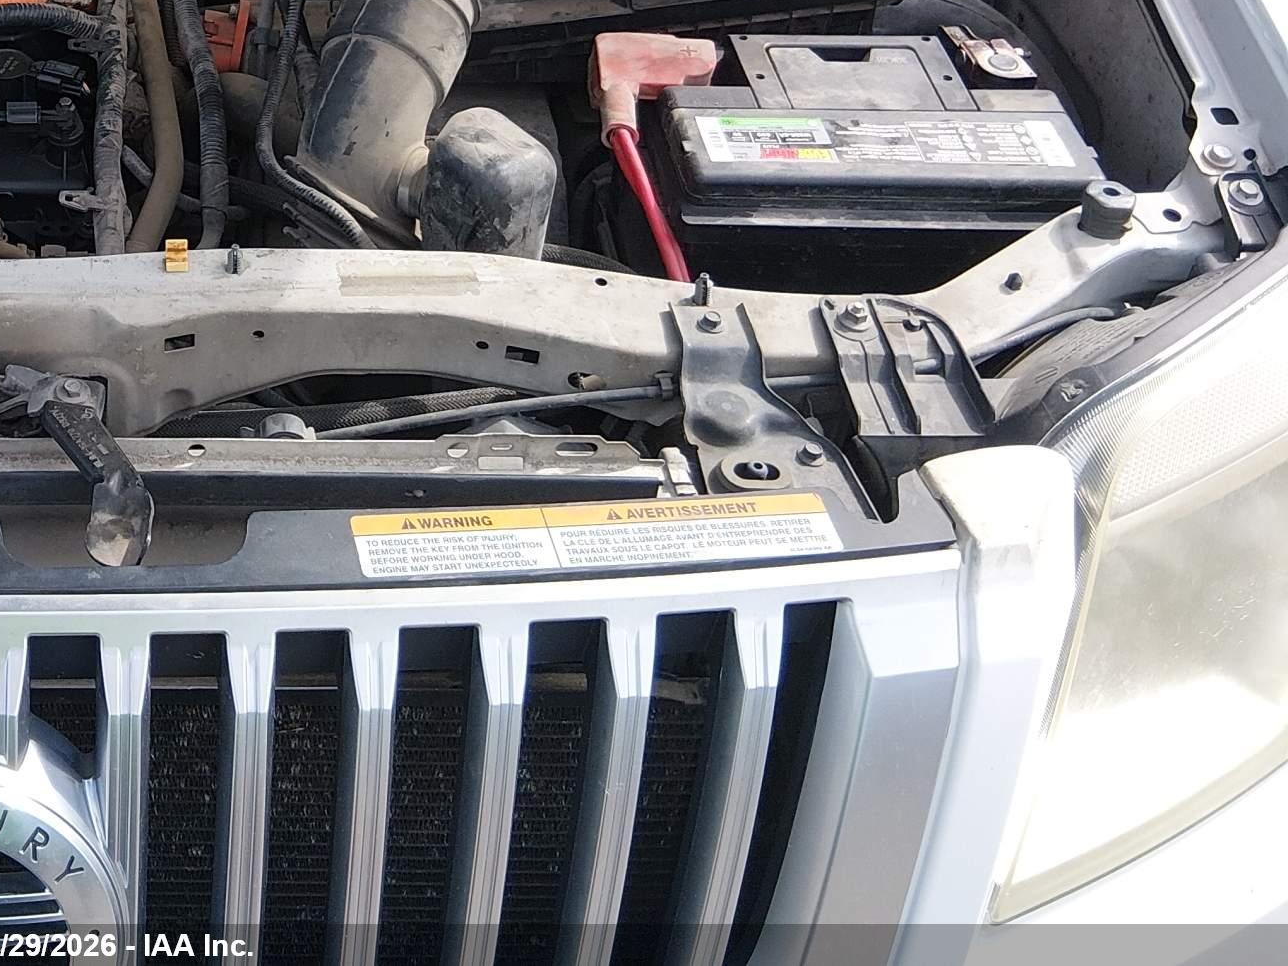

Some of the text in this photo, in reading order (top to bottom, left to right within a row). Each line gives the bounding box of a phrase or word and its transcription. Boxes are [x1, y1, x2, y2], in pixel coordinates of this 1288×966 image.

[628, 502, 756, 519] AVERTISSEMENT
[417, 515, 493, 530] WARNING
[366, 540, 379, 548] TO
[381, 538, 420, 547] REDUCE
[422, 537, 440, 545] THE
[442, 535, 464, 544] RISK
[466, 535, 479, 543] OF
[368, 541, 543, 557] REMOVE THE KEY FROM THE IGNITION
[371, 556, 409, 566] BEFORE
[412, 554, 456, 563] WORKING
[459, 552, 491, 561] UNDER
[373, 566, 409, 575] ENGINE
[432, 563, 461, 571] START
